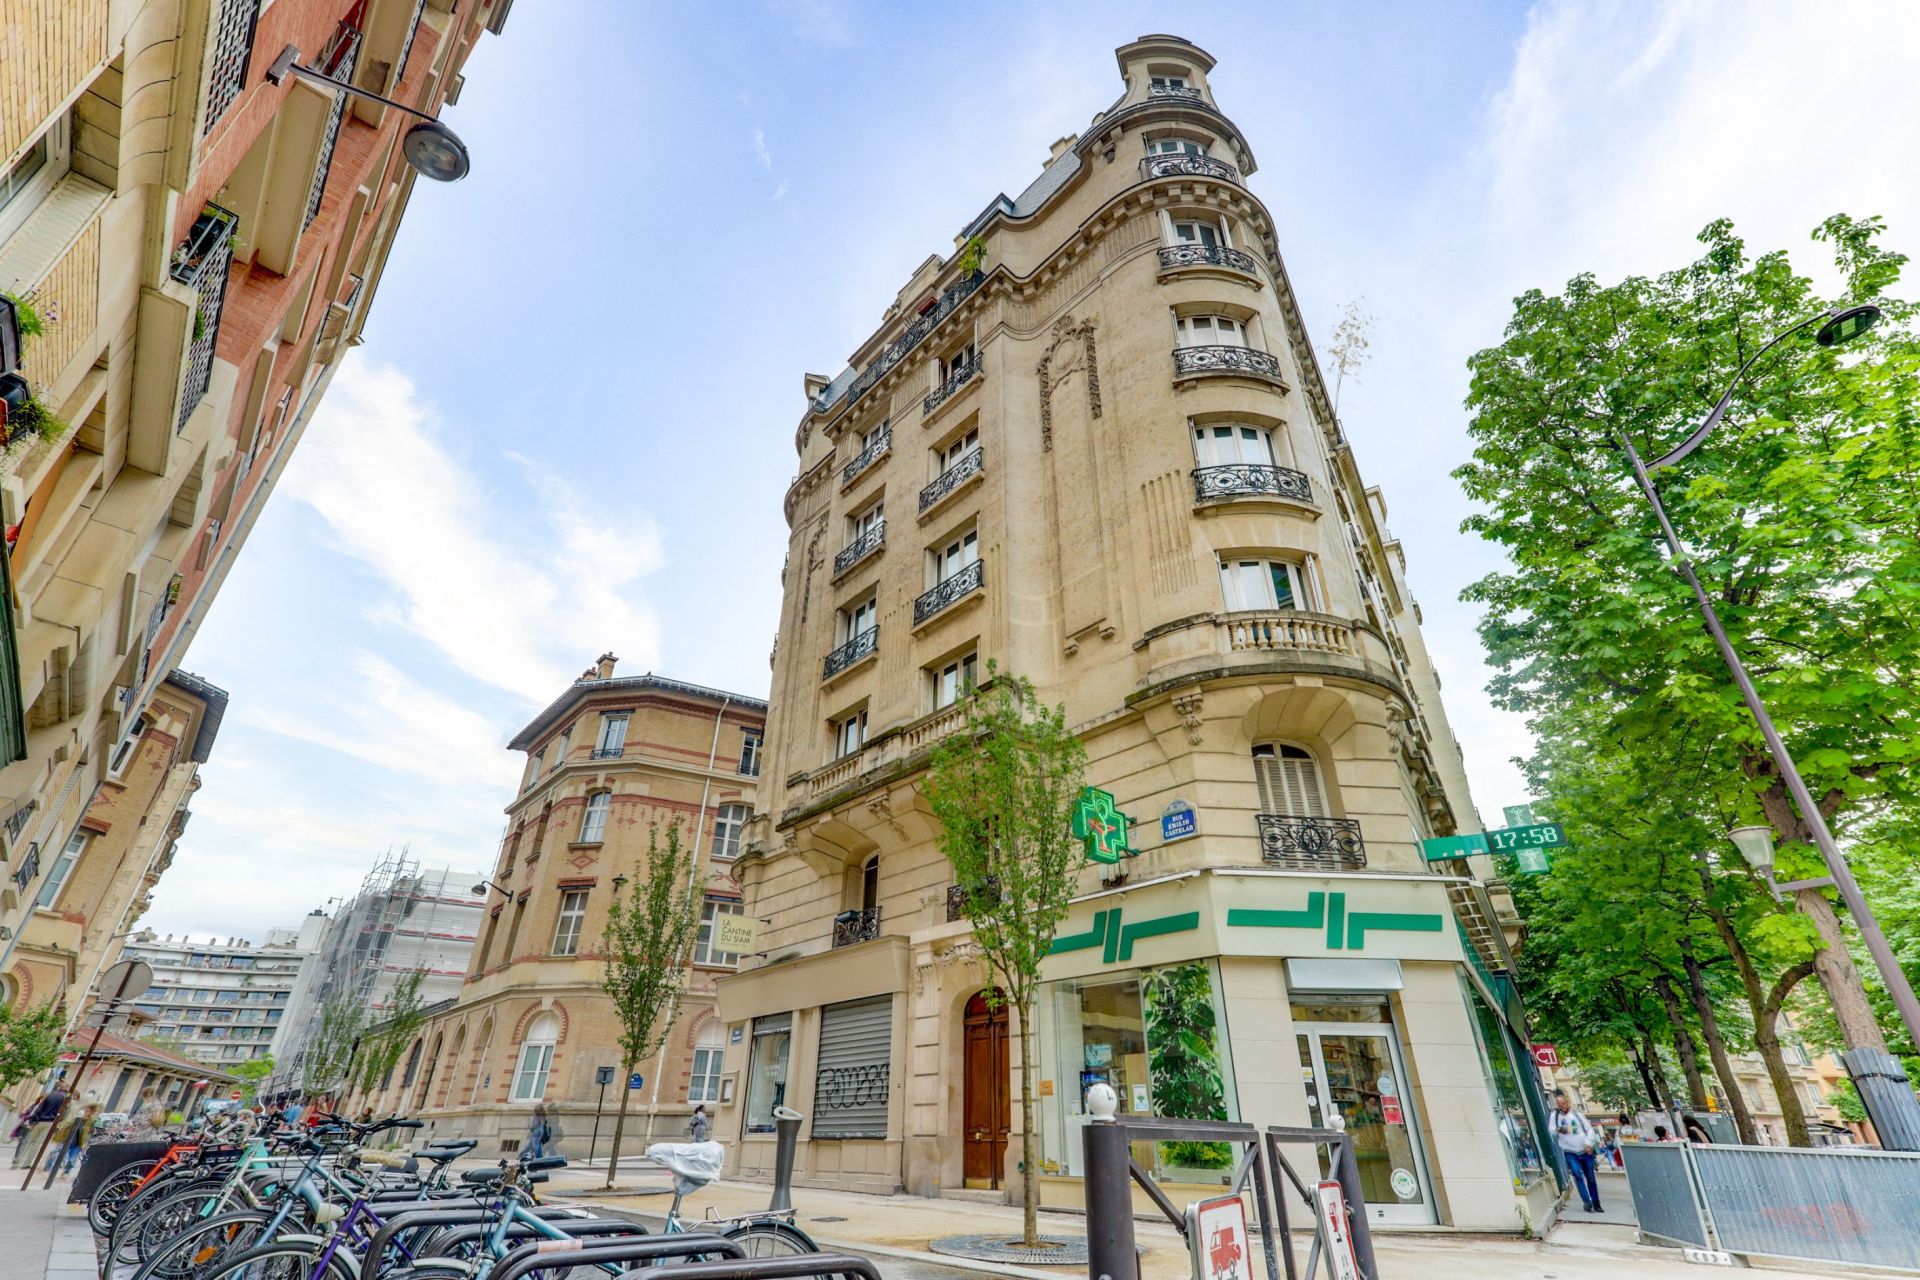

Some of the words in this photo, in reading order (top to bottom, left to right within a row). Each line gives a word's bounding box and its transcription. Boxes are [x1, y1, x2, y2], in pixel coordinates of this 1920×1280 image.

[1172, 814, 1184, 822] RUE
[1168, 819, 1190, 830] EMILIO
[1165, 824, 1194, 837] CASTELAR
[1494, 827, 1558, 849] 17:58
[722, 926, 752, 937] CANTINE
[721, 934, 731, 942] DU
[733, 935, 751, 945] SIAM
